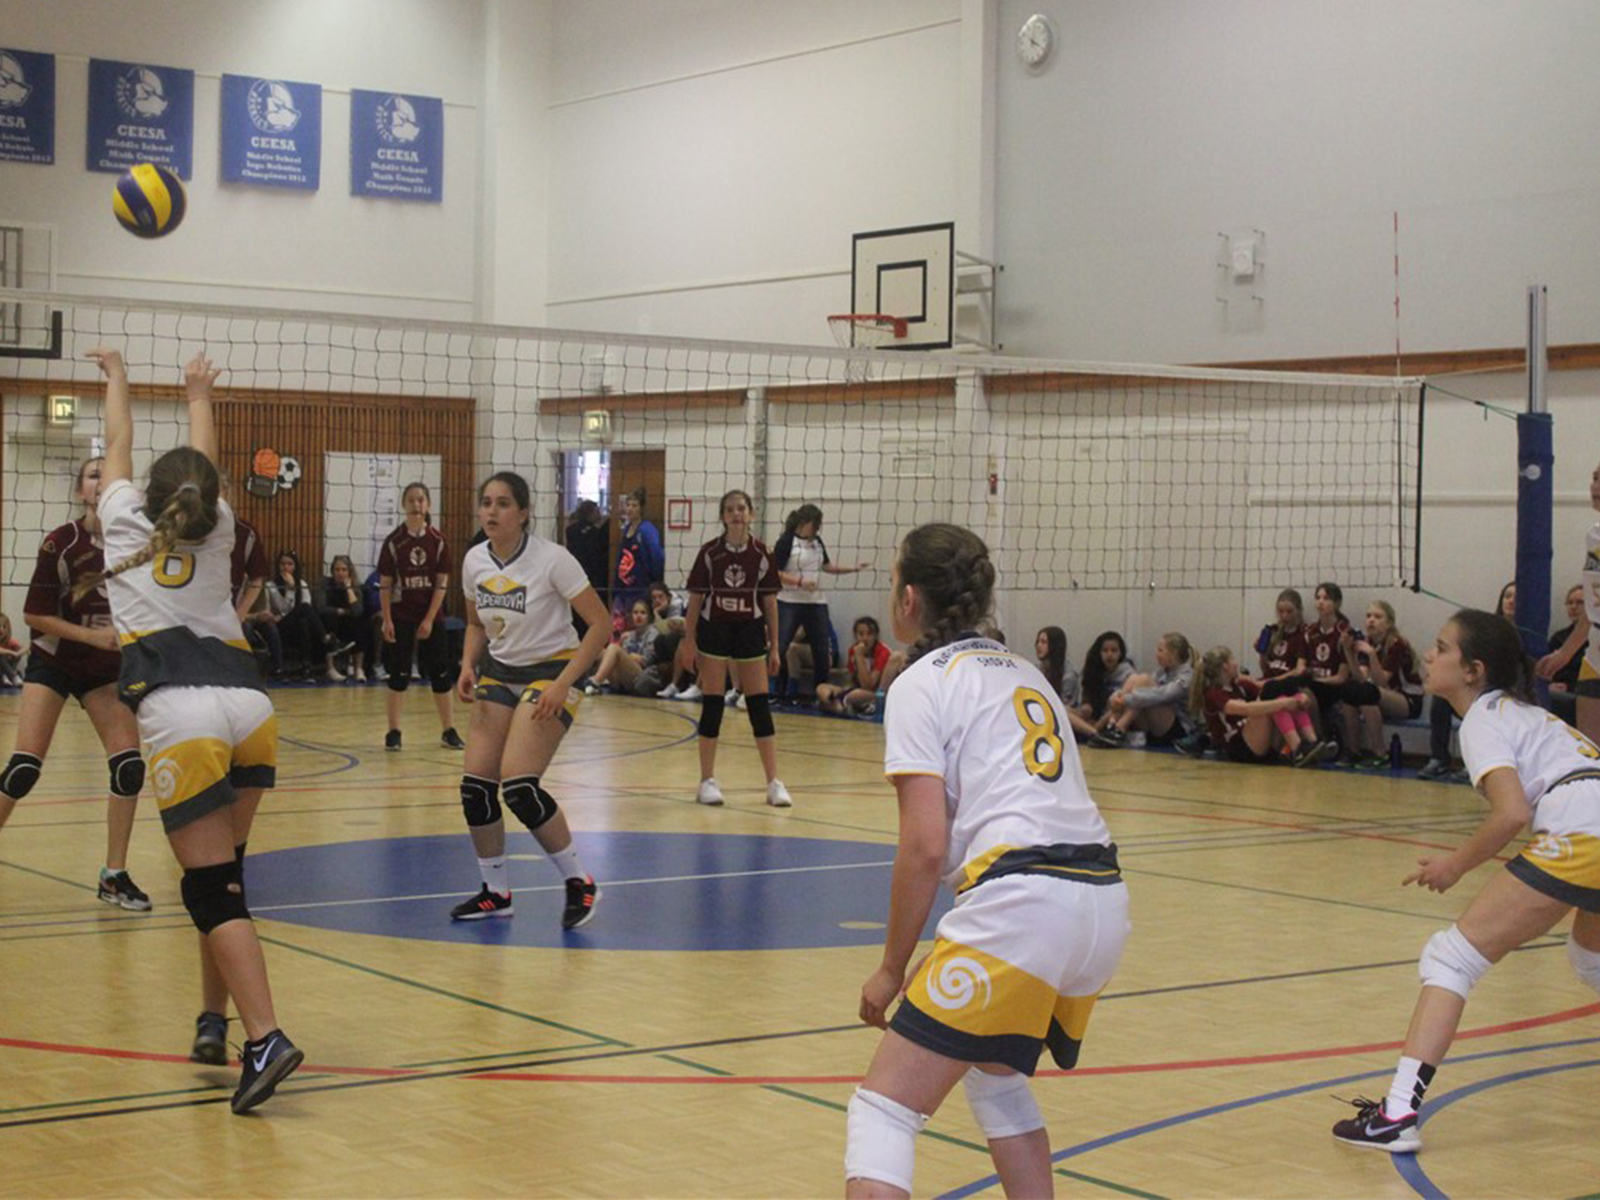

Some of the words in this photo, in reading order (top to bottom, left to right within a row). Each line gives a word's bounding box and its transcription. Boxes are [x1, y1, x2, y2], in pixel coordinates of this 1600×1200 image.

[117, 124, 167, 140] CEESA
[105, 138, 140, 149] Middle
[141, 142, 174, 152] School
[250, 136, 297, 151] CEESA
[108, 149, 134, 160] Math
[275, 154, 302, 164] School
[377, 148, 419, 162] CEESA
[1012, 686, 1064, 783] 8
